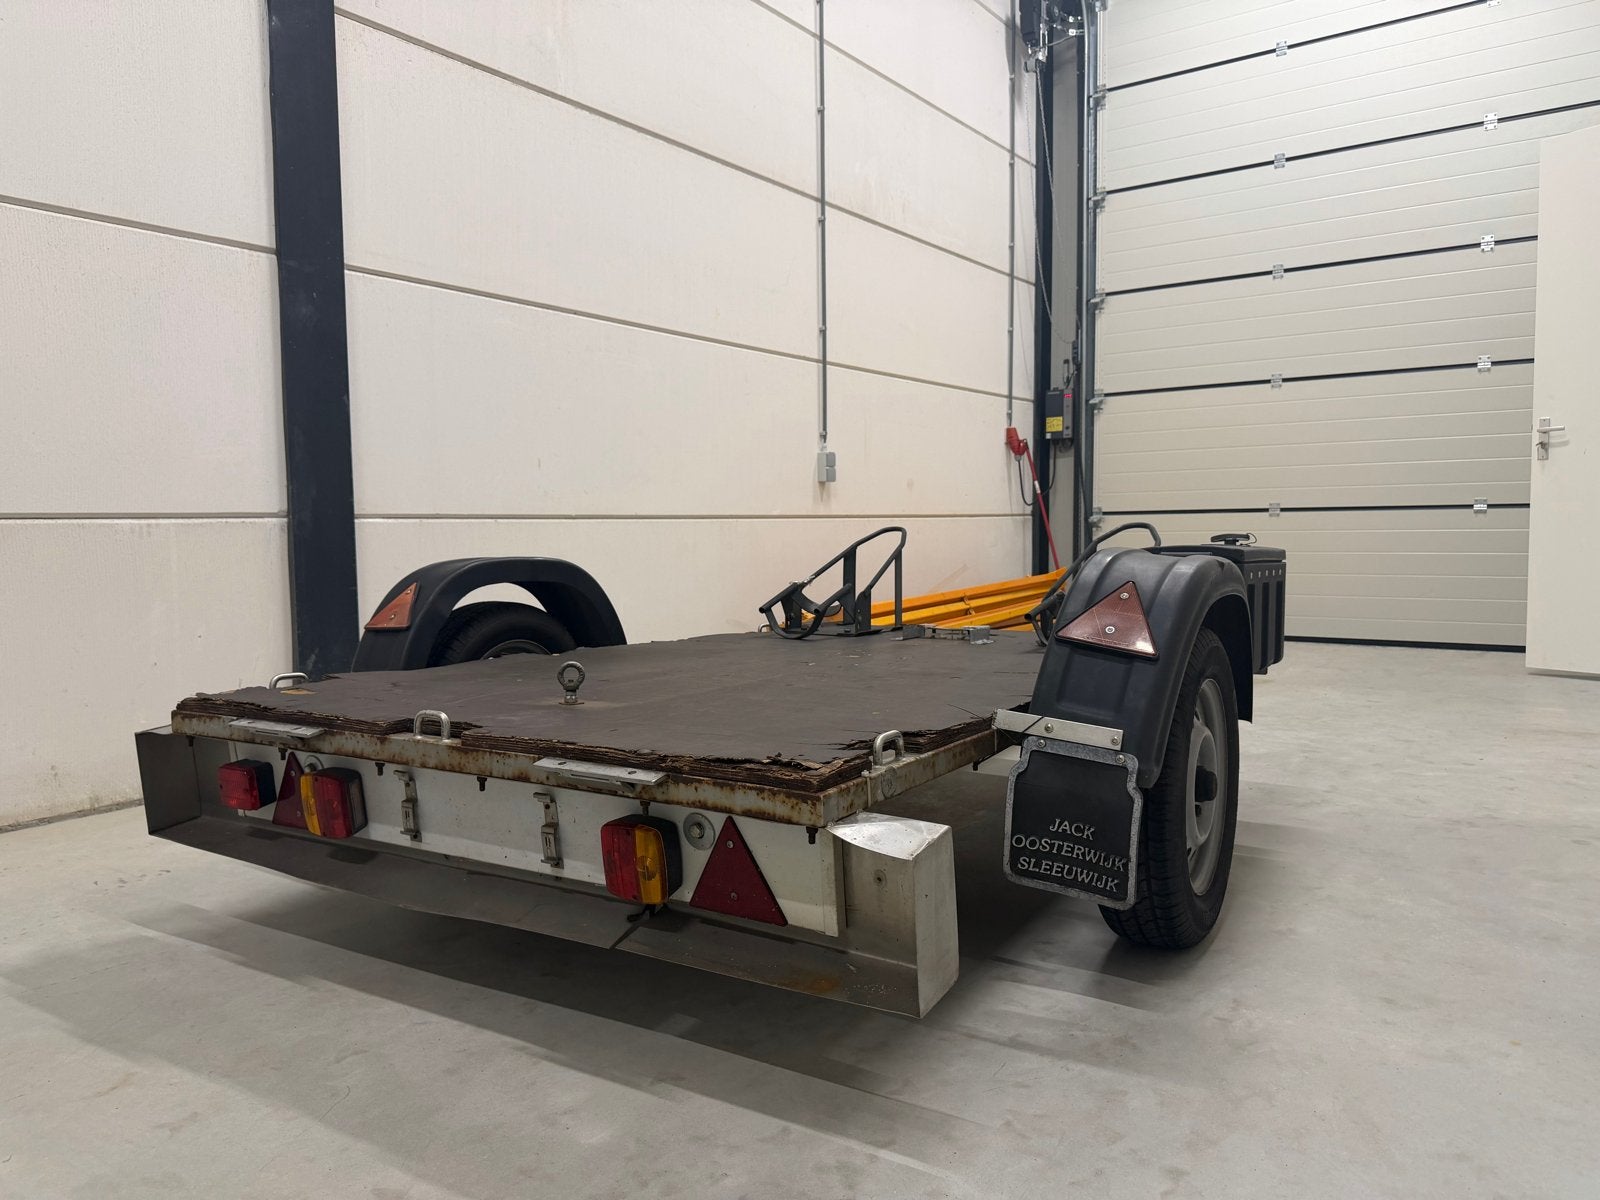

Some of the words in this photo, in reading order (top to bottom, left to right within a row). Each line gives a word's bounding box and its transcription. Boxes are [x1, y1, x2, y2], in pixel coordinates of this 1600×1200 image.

[1050, 819, 1095, 840] JACK
[1012, 835, 1127, 872] OOSTERWIJK
[1018, 857, 1119, 892] SLEEUWIJK
